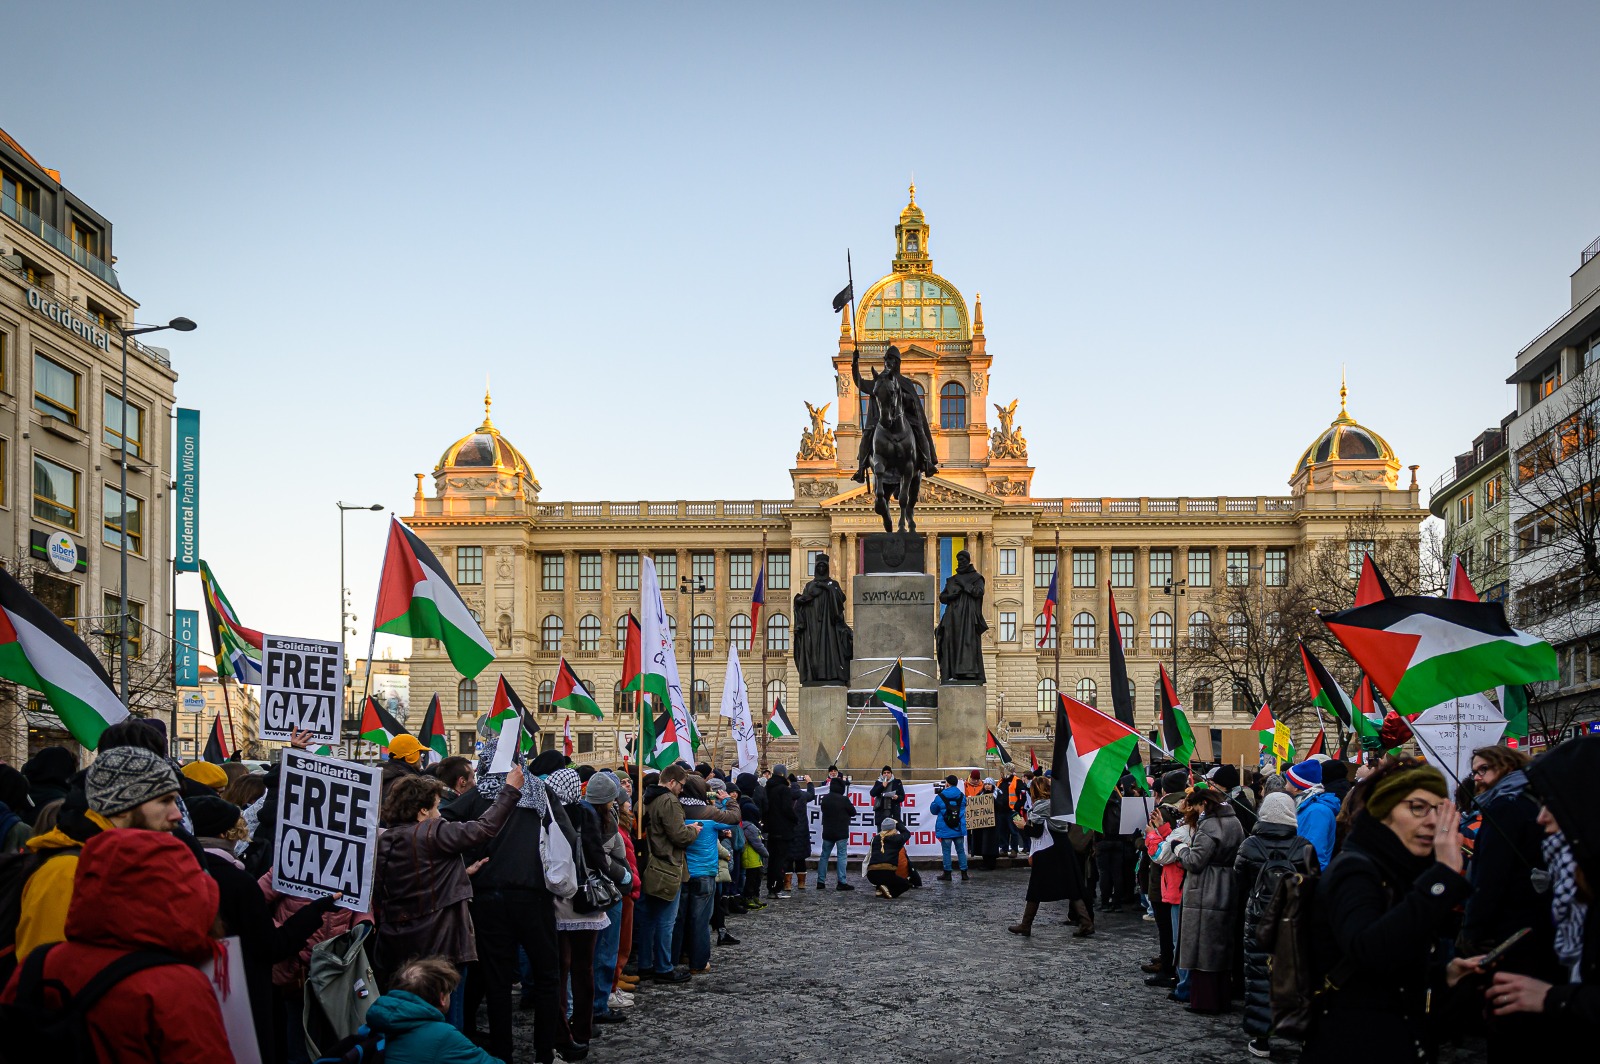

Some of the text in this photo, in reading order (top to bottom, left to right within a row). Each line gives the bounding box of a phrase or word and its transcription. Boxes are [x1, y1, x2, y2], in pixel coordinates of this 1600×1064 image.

[26, 288, 111, 353] Occidental
[182, 436, 194, 563] Occidental Praha Wilson
[51, 544, 75, 558] albert
[182, 617, 191, 679] HOTEL
[276, 641, 329, 654] Solidarita
[266, 651, 338, 692] FREE
[184, 697, 204, 705] albert
[266, 691, 332, 733] GAZA
[296, 759, 361, 783] Solidarita
[283, 771, 371, 839] FREE
[281, 828, 359, 894] GAZA
